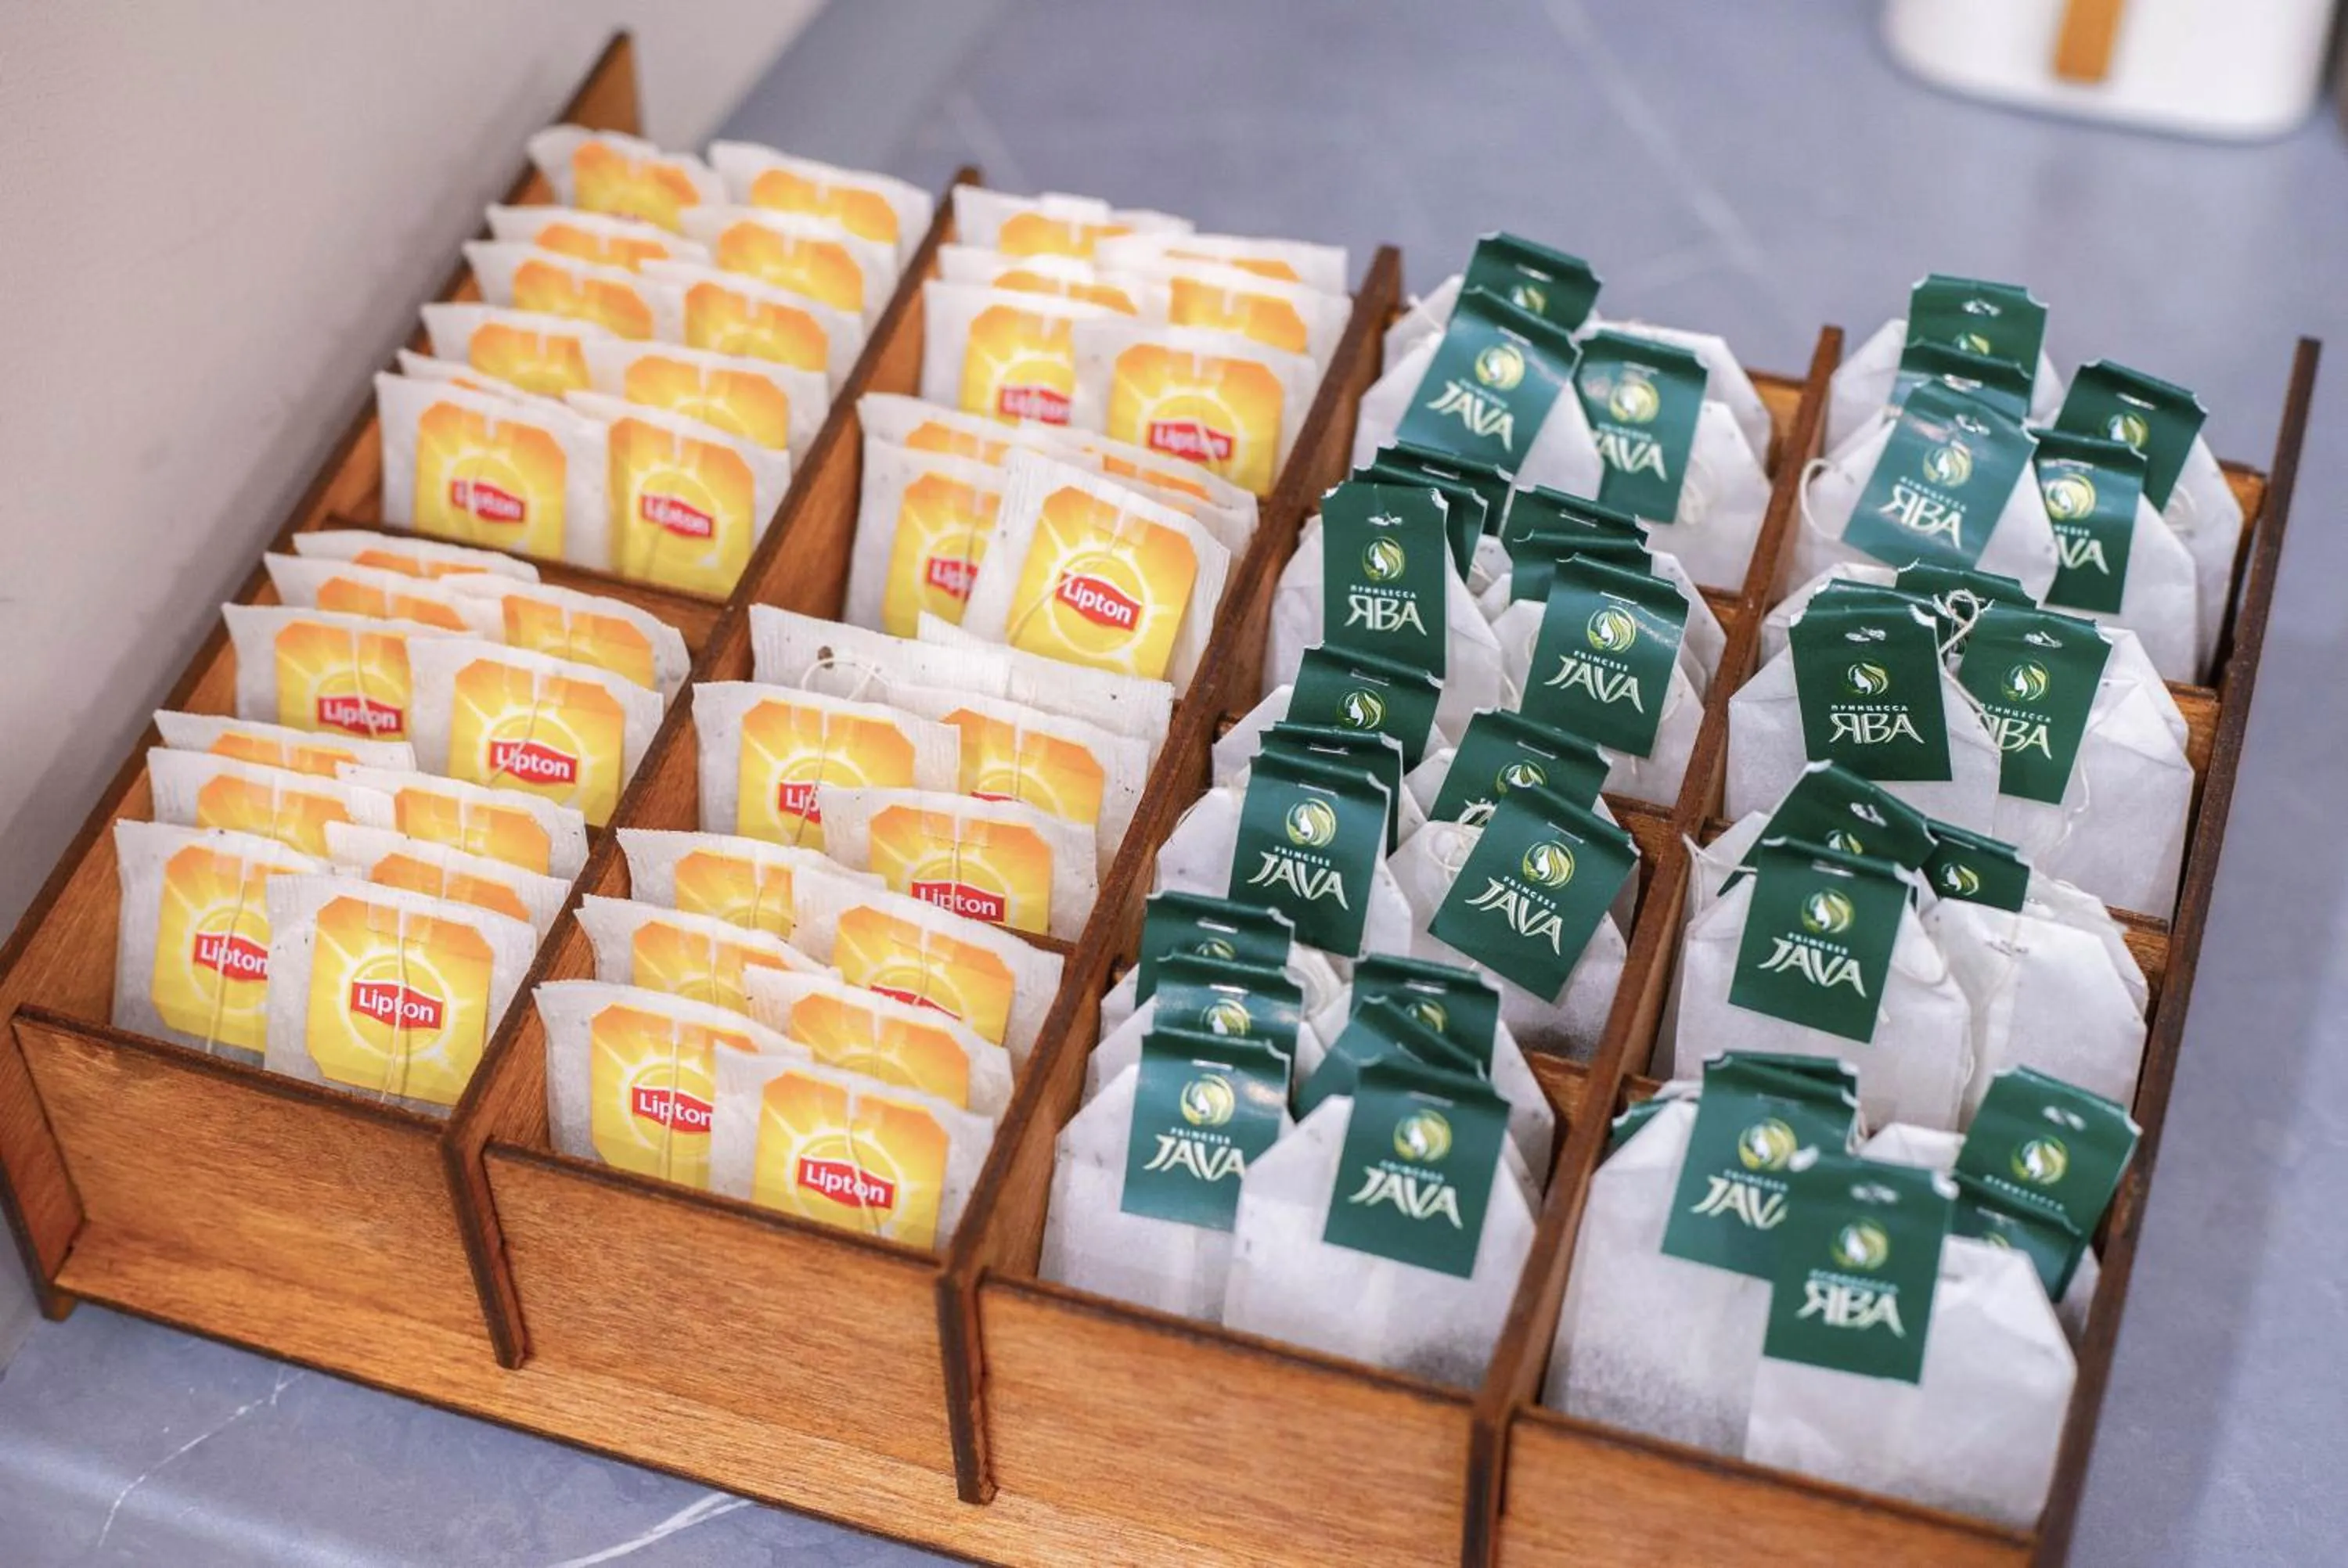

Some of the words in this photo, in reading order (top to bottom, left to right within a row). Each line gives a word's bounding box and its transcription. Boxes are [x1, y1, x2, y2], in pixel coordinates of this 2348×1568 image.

[1426, 380, 1514, 452] JAVA
[1592, 431, 1669, 482] AVA
[1879, 484, 1961, 550] ЯВА
[2058, 534, 2109, 575] VA
[1063, 579, 1132, 624] Lipton
[1344, 594, 1428, 636] ЯВА
[1543, 654, 1644, 714] JAVA
[324, 699, 396, 729] Lipton
[1829, 713, 1925, 744] ЯВА
[497, 746, 570, 779] Lipton
[1246, 851, 1349, 911] JAVA
[1464, 876, 1563, 955] JAVA
[200, 939, 268, 975] Lipton
[1757, 937, 1867, 998] JAVA
[358, 987, 434, 1022] Lipton
[639, 1092, 711, 1127] Lipton
[1143, 1134, 1245, 1181] JAVA
[805, 1164, 885, 1203] Lipton
[1348, 1166, 1463, 1229] JAVA
[1795, 1278, 1906, 1338] ЯВА
